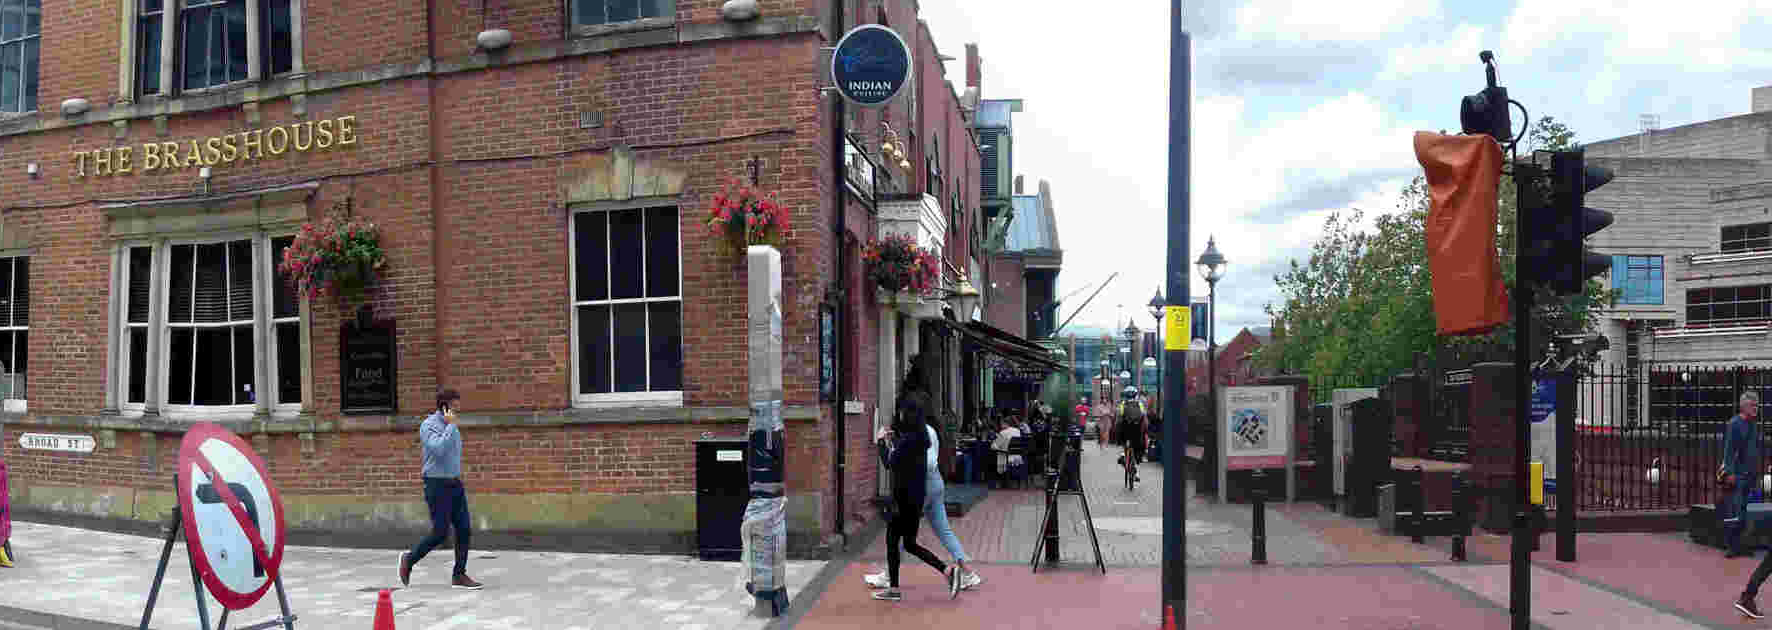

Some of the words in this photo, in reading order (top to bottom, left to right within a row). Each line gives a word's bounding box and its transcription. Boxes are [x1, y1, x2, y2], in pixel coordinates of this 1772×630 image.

[849, 80, 892, 90] INDIAN
[76, 145, 133, 177] THE
[143, 115, 358, 171] BRASSHOUSE
[27, 438, 60, 450] BROAD
